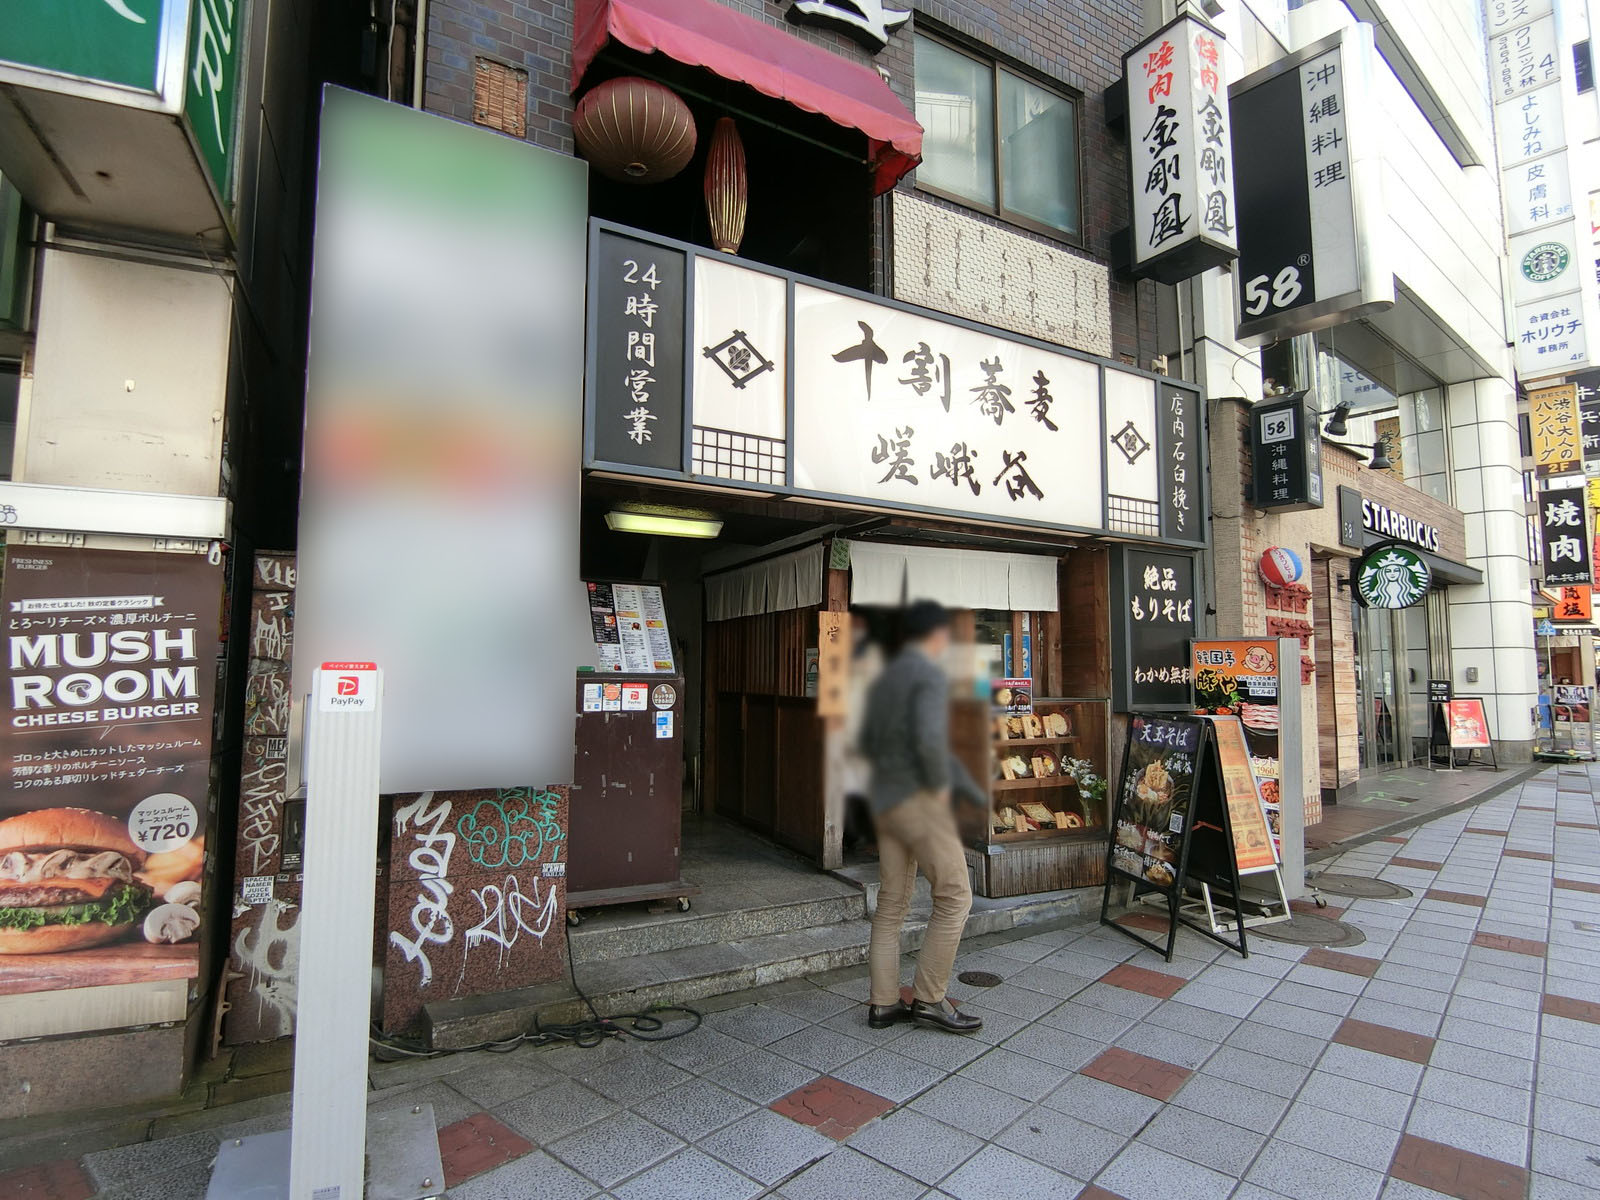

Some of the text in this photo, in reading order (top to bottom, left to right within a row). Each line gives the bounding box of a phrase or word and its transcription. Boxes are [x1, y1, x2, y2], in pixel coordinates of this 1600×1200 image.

[1144, 40, 1176, 104] 焼肉
[1196, 34, 1218, 95] 焼肉
[1307, 63, 1345, 189] 沖縄料理
[1522, 95, 1543, 155] よしみね
[1142, 105, 1192, 248] 金剛園
[1197, 95, 1234, 237] 金剛園
[1527, 164, 1549, 220] 皮膚科
[624, 259, 661, 445] 24時間営業
[1521, 320, 1583, 343] ホリウチ
[832, 320, 1058, 432] 十割蕎麦
[1535, 402, 1555, 462] ハンバーグ
[1553, 398, 1575, 459] 渋谷大人の
[871, 425, 1044, 501] 嵯峨谷
[1170, 393, 1189, 533] 店内石臼挽き
[1271, 443, 1289, 500] 沖縄料理
[1548, 462, 1570, 473] 2F
[1361, 498, 1439, 553] STARBUCKS
[1544, 499, 1581, 563] 焼肉
[1144, 565, 1177, 592] 絶品
[1131, 595, 1192, 622] もりそば
[10, 628, 199, 670] MUSH
[1196, 649, 1235, 667] 韓国亭
[11, 666, 200, 711] ROOM
[13, 702, 200, 728] CHEESE BURGER
[331, 697, 365, 706] PayPay
[1140, 724, 1190, 746] 天玉そば
[138, 822, 190, 842] ¥720
